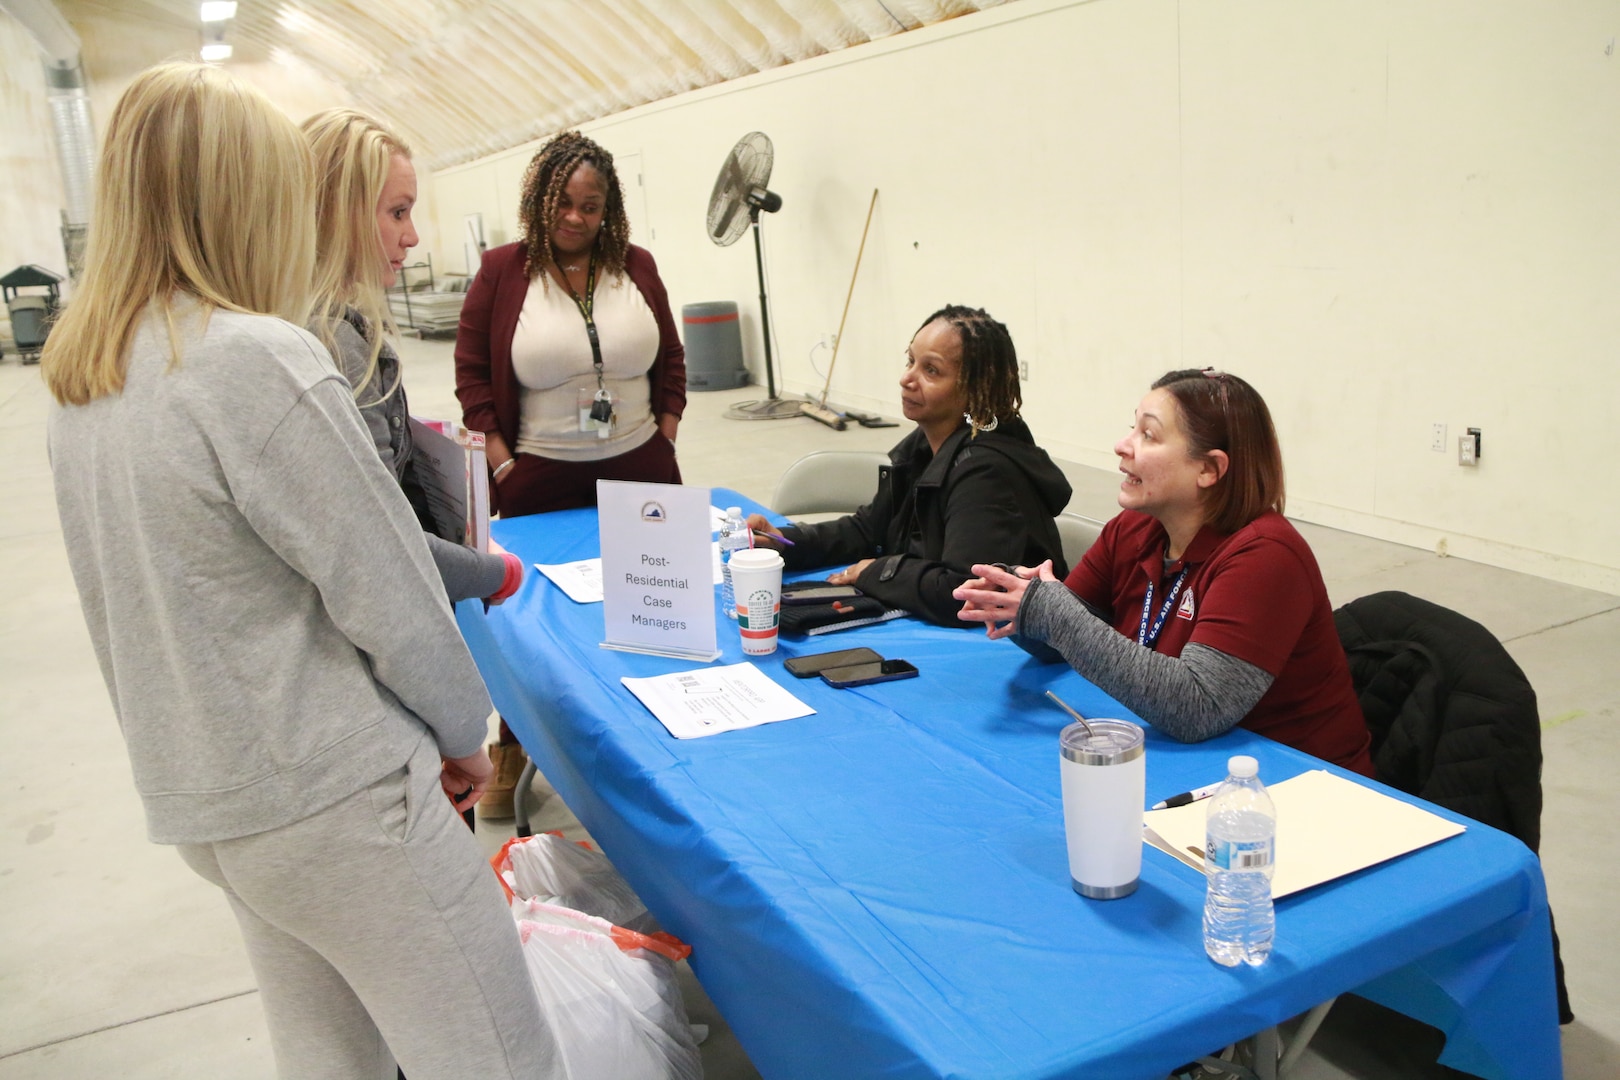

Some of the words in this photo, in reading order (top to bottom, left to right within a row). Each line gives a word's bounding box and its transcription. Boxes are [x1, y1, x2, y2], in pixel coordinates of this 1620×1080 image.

[641, 554, 670, 567] Post-
[625, 573, 689, 590] Residential
[643, 595, 673, 608] Case
[631, 613, 687, 631] Managers
[1149, 621, 1162, 639] U.S.
[1160, 601, 1172, 619] AIR
